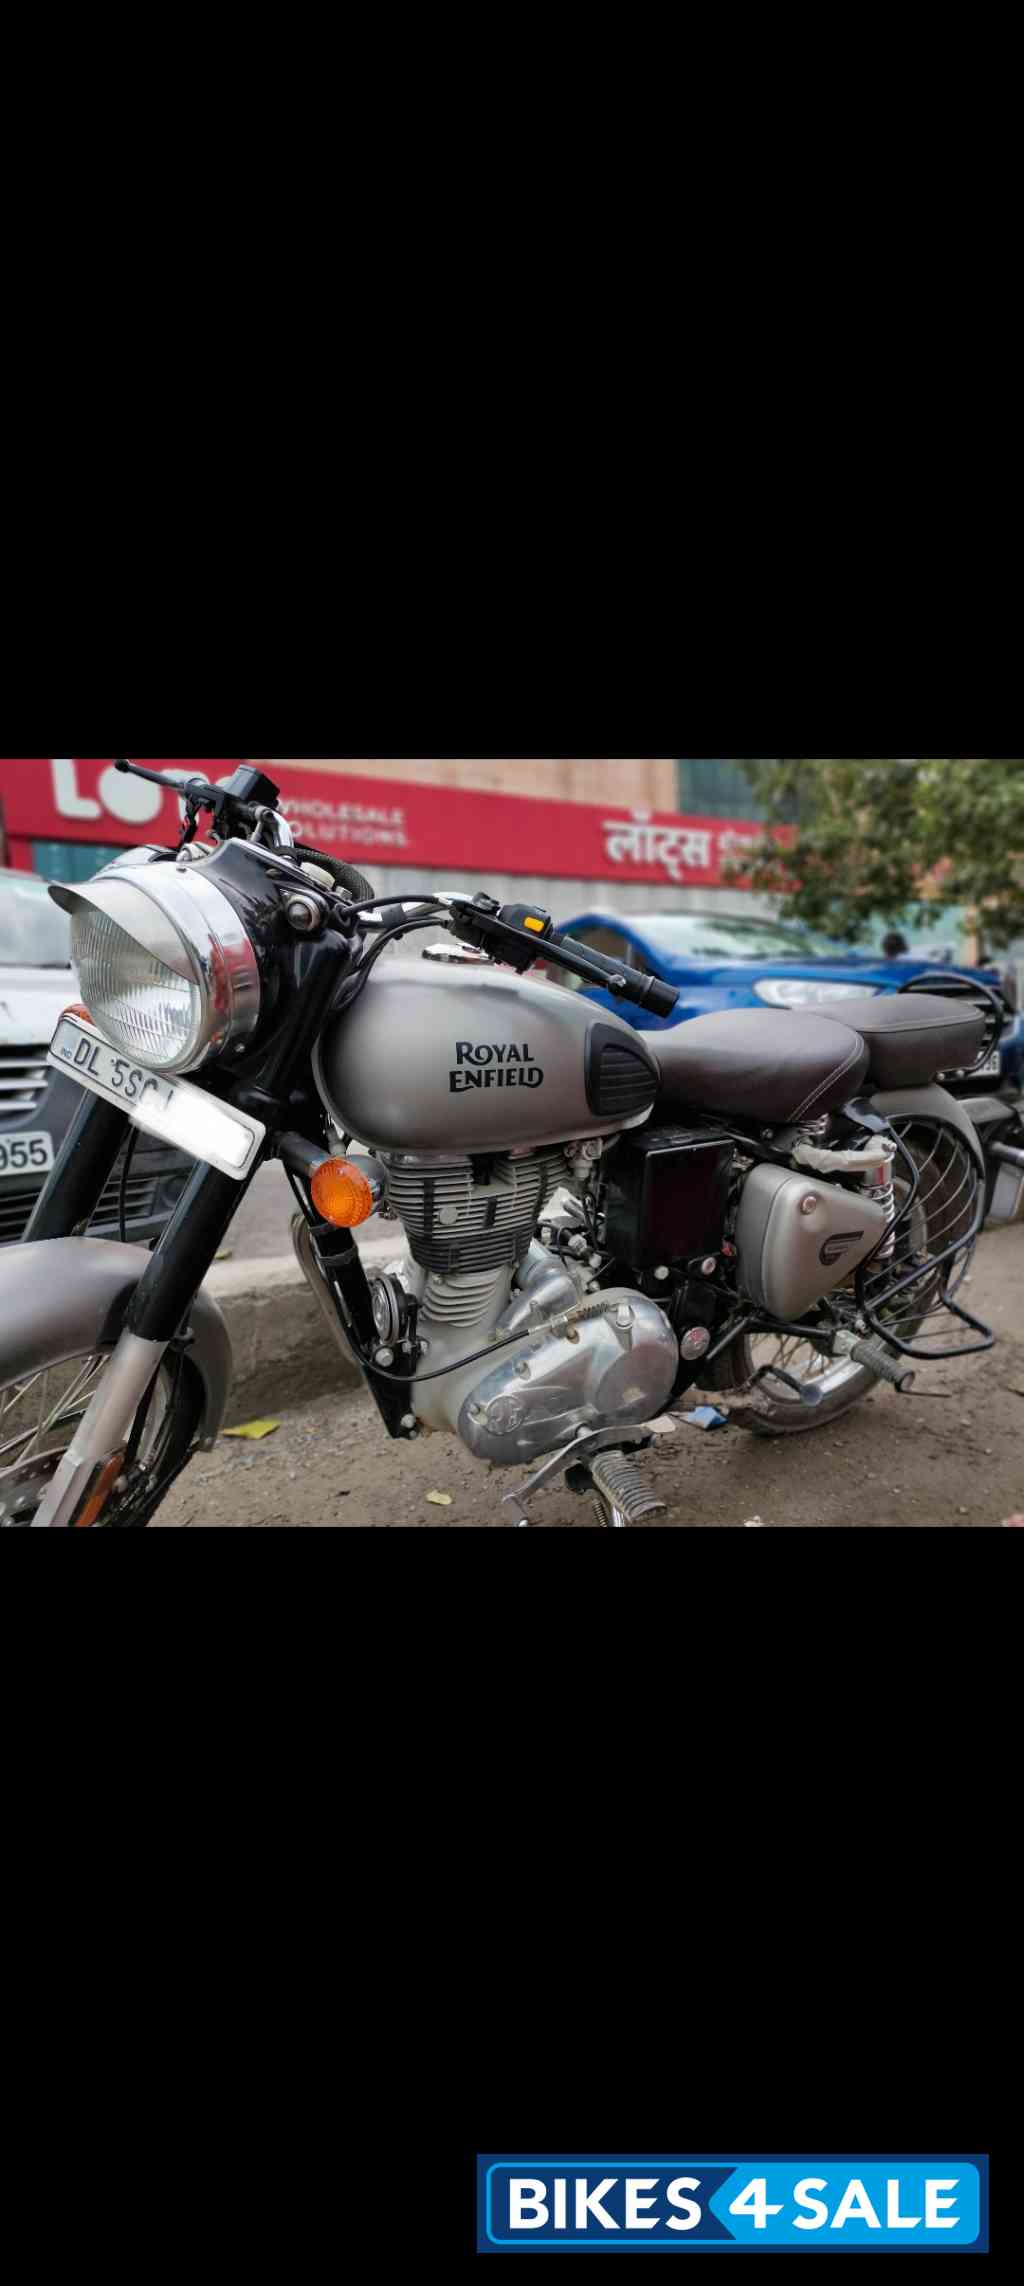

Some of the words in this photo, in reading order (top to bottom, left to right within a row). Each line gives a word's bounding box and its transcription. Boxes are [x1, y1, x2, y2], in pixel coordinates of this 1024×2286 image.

[289, 820, 407, 847] OLUTIONS
[74, 1038, 99, 1076] DL
[456, 1042, 535, 1066] ROYAL
[449, 1067, 544, 1093] ENFIELD
